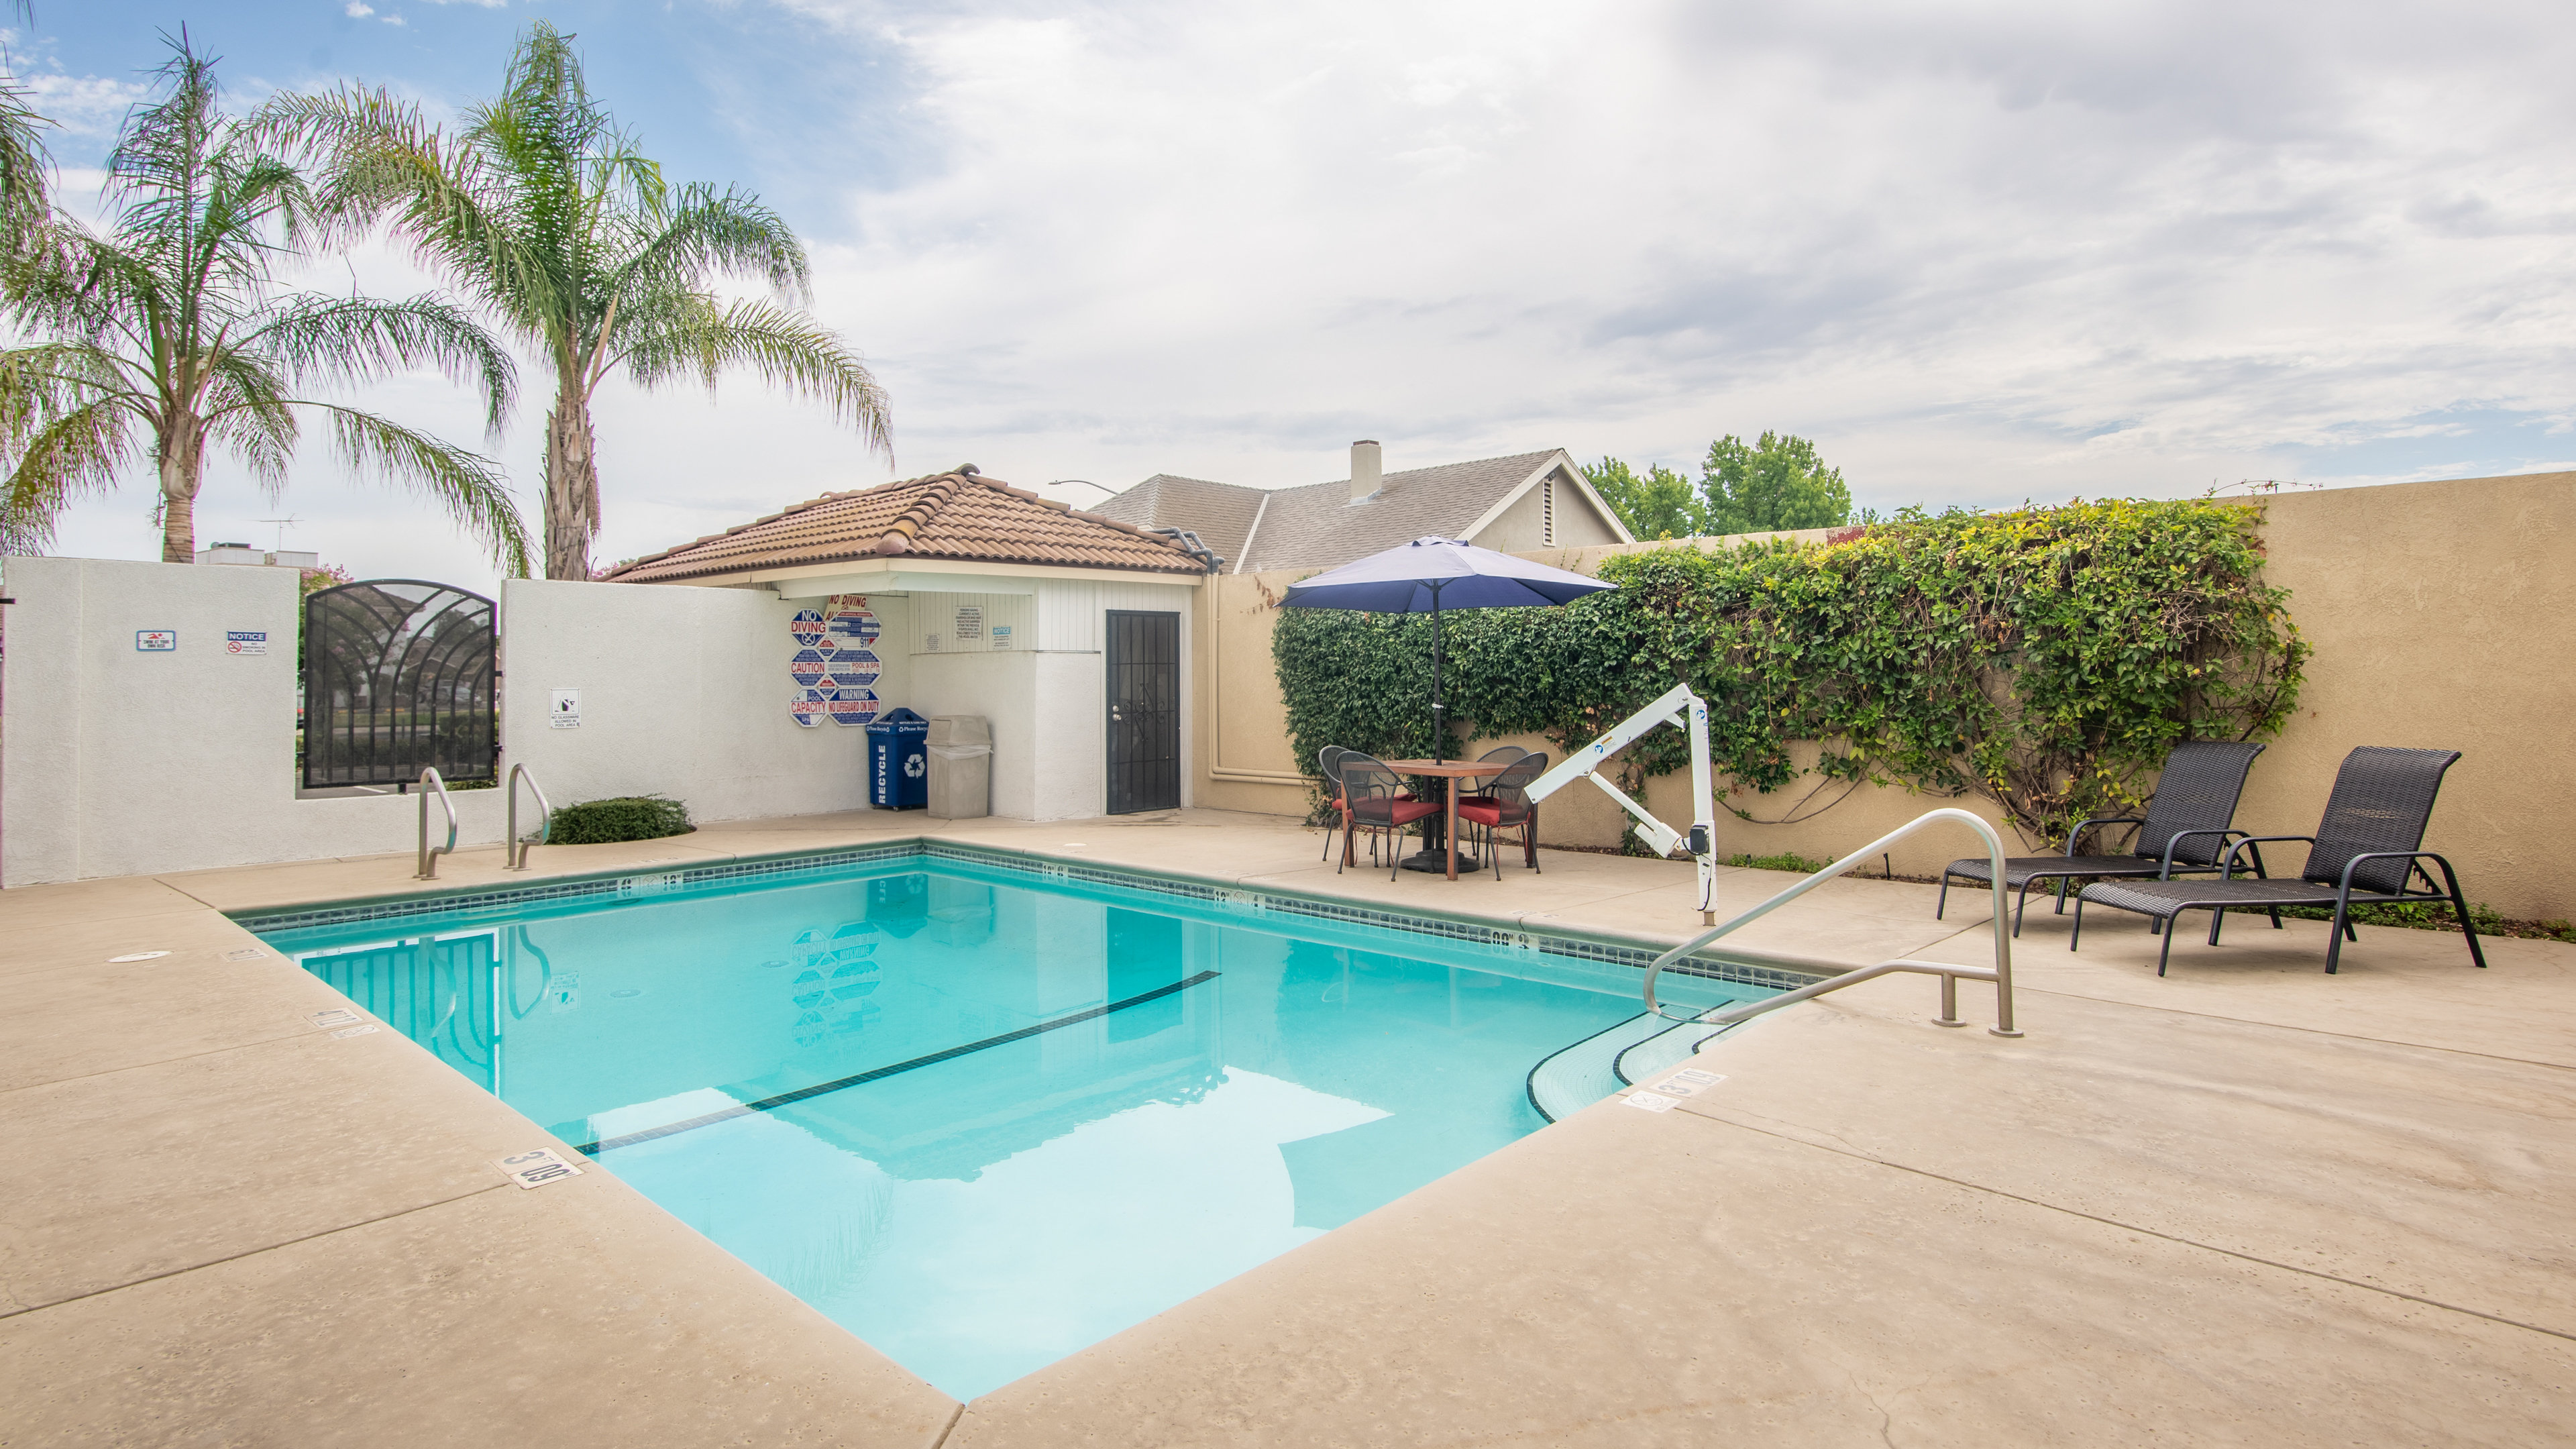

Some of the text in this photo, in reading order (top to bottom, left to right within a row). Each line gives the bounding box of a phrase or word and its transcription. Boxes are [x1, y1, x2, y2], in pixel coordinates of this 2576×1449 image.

[829, 595, 866, 607] NO DIVING
[802, 610, 816, 621] NO
[792, 622, 826, 633] DIVING
[860, 638, 869, 647] 911
[792, 663, 824, 673] CAUTION
[839, 690, 869, 700] WARNING
[792, 702, 826, 712] CAPACITY
[829, 702, 879, 712] NO LIFEGUARD ON DUTY
[1658, 1085, 1691, 1094] 3
[504, 1151, 545, 1165] 3
